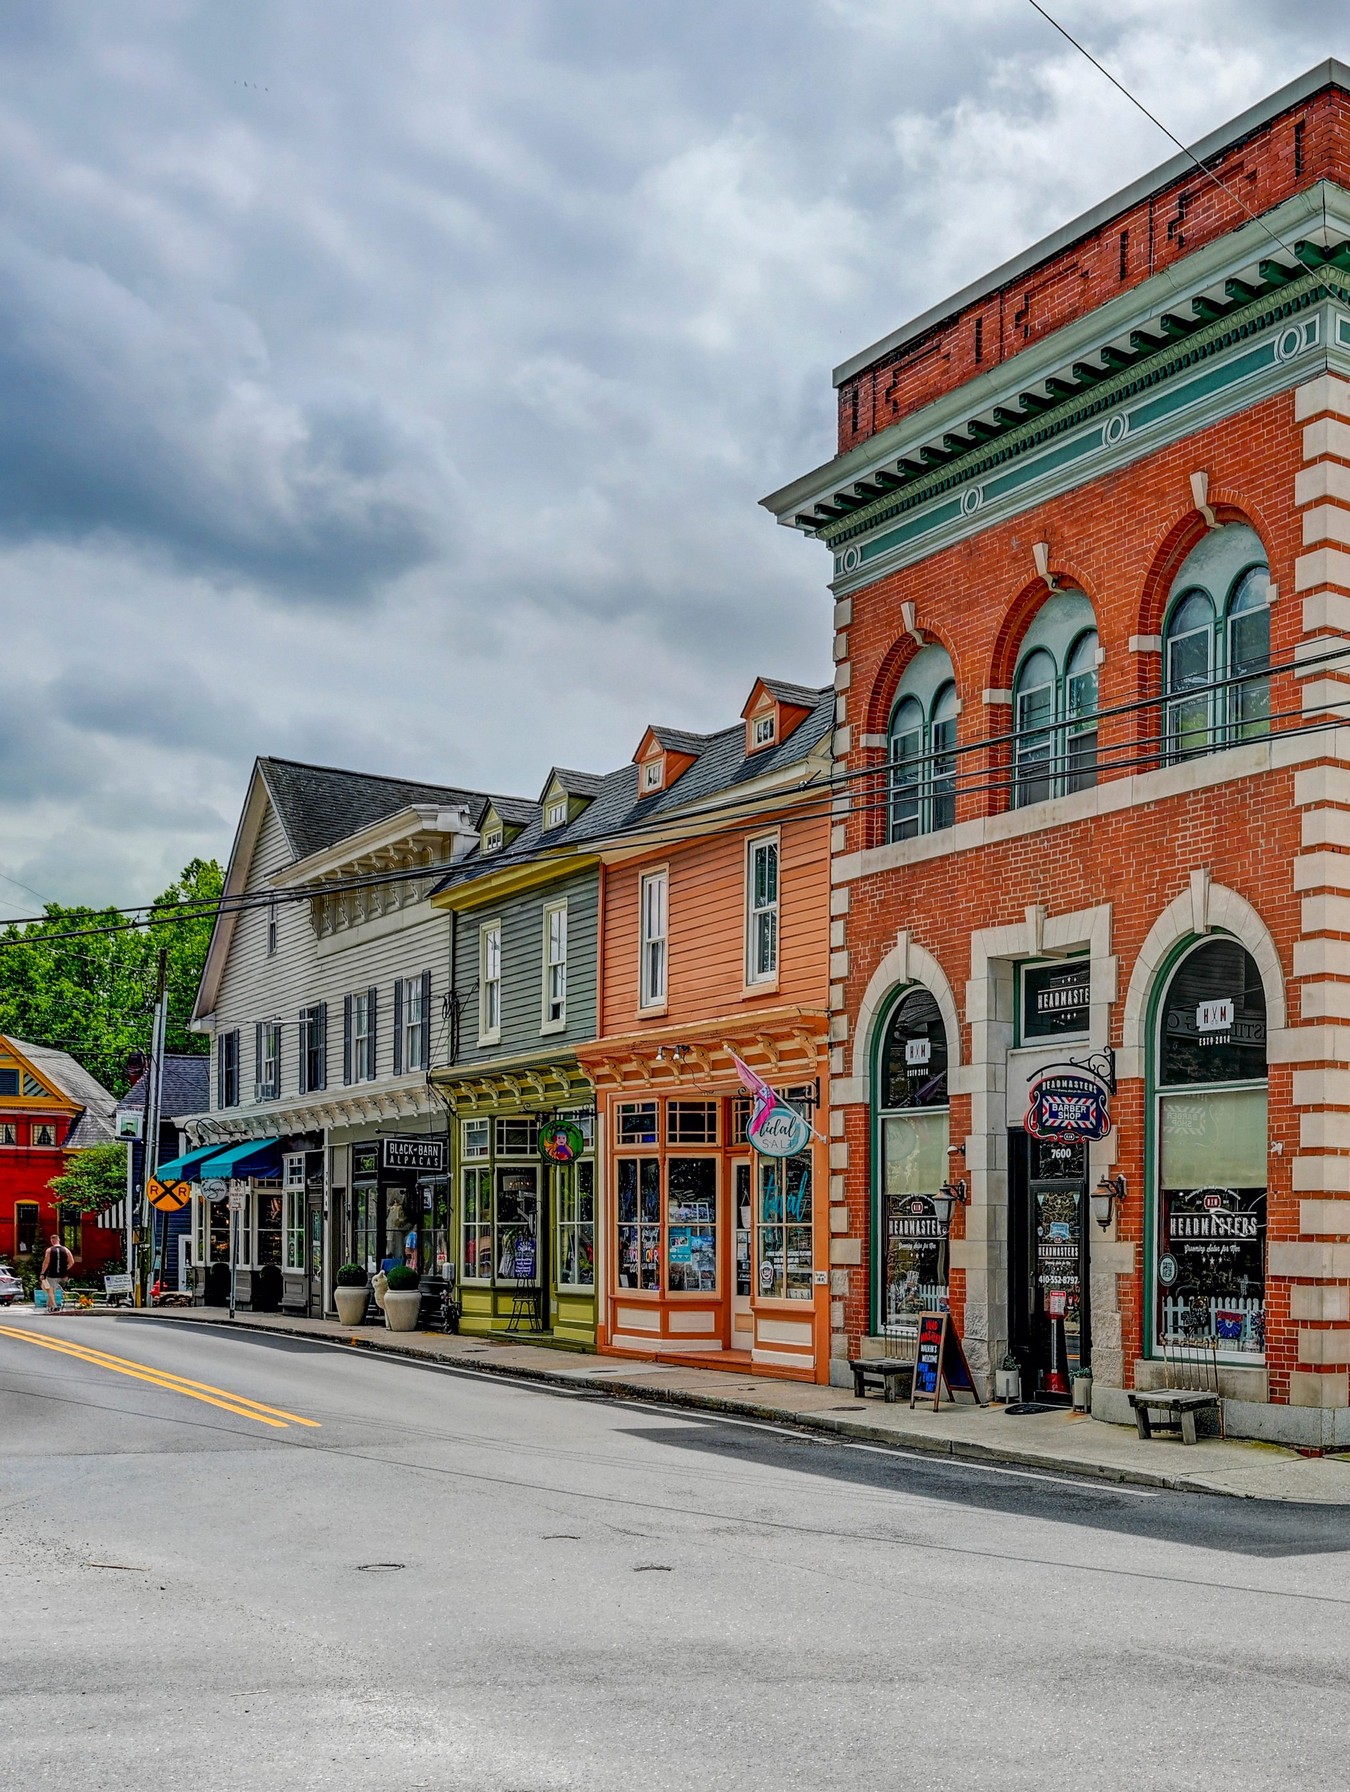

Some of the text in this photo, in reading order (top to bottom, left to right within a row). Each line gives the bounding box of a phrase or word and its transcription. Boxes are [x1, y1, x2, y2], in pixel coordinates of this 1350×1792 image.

[1038, 988, 1089, 1010] HEADMASTE
[1203, 1006, 1226, 1024] H M
[1215, 1035, 1230, 1045] 2014
[1042, 1080, 1097, 1094] HEADMASTERS
[1052, 1103, 1087, 1113] BARBER
[1057, 1111, 1081, 1120] SHOP
[1050, 1148, 1072, 1159] 7600
[389, 1155, 439, 1166] ALPACAS
[150, 1185, 187, 1197] R R
[889, 1220, 942, 1236] HEADMASTER
[1170, 1217, 1257, 1236] HEADMASTERS
